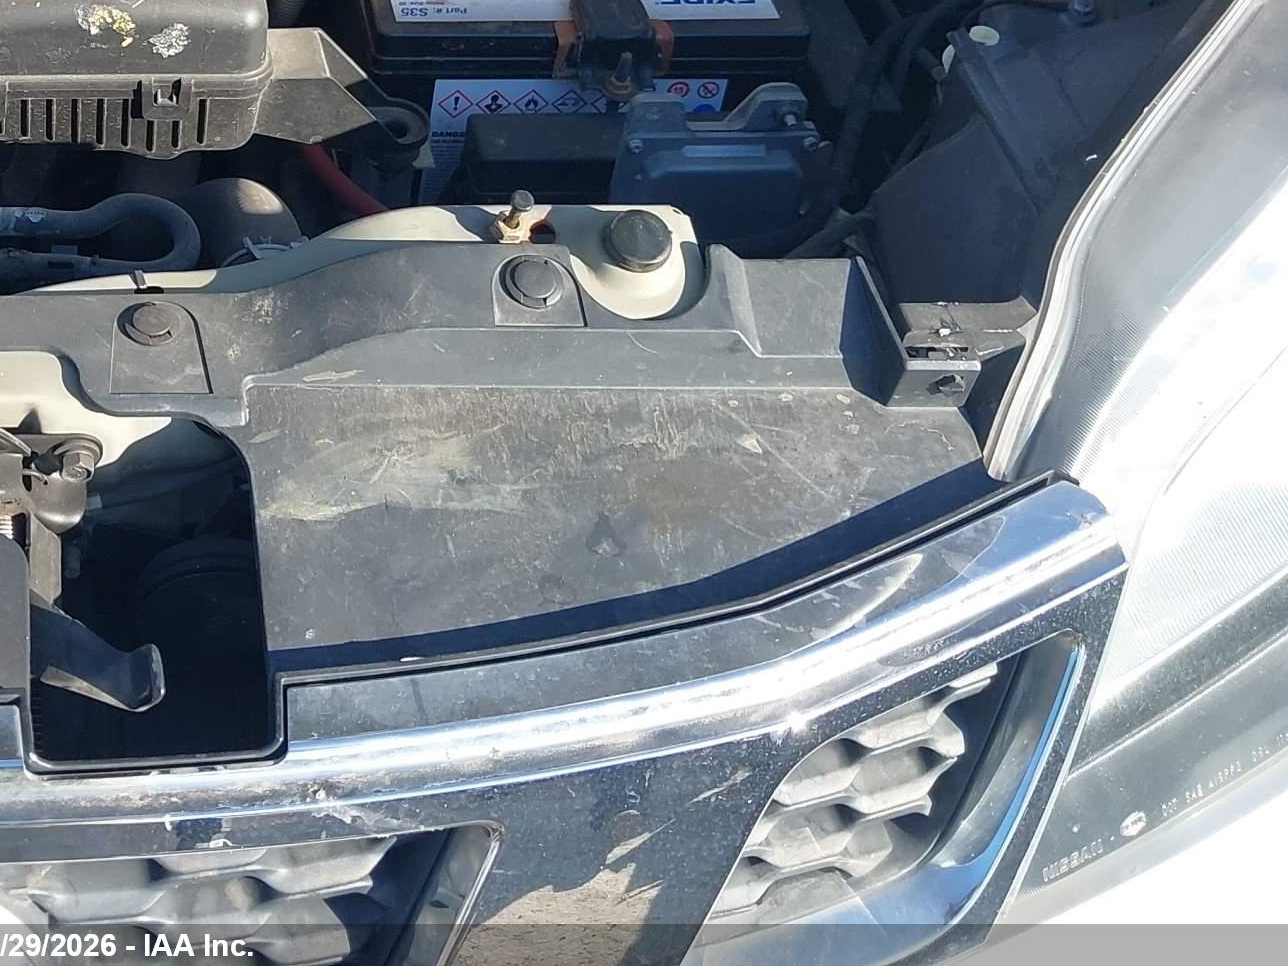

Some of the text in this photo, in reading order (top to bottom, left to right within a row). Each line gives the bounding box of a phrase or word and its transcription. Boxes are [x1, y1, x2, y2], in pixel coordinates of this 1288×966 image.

[400, 8, 429, 17] S35
[446, 7, 468, 15] Part
[1041, 838, 1104, 882] NISSAN
